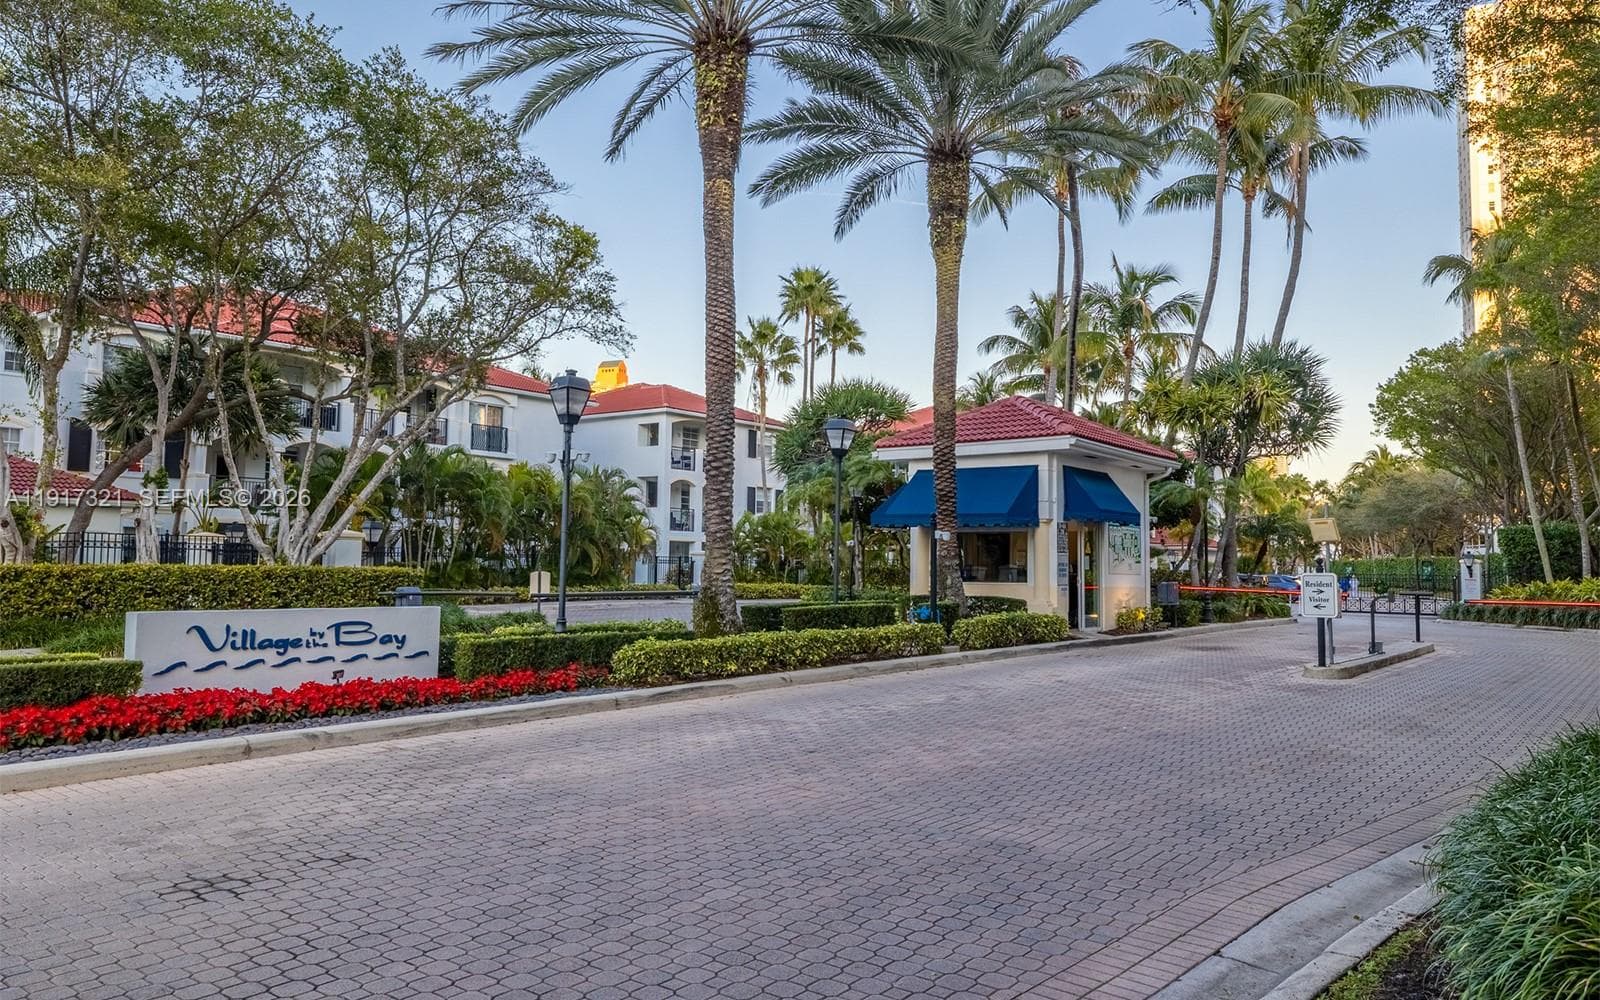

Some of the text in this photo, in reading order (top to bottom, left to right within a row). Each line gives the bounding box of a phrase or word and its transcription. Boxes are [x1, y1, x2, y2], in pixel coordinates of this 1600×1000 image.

[1305, 580, 1333, 588] Resident
[186, 620, 407, 656] Village by the Bay
